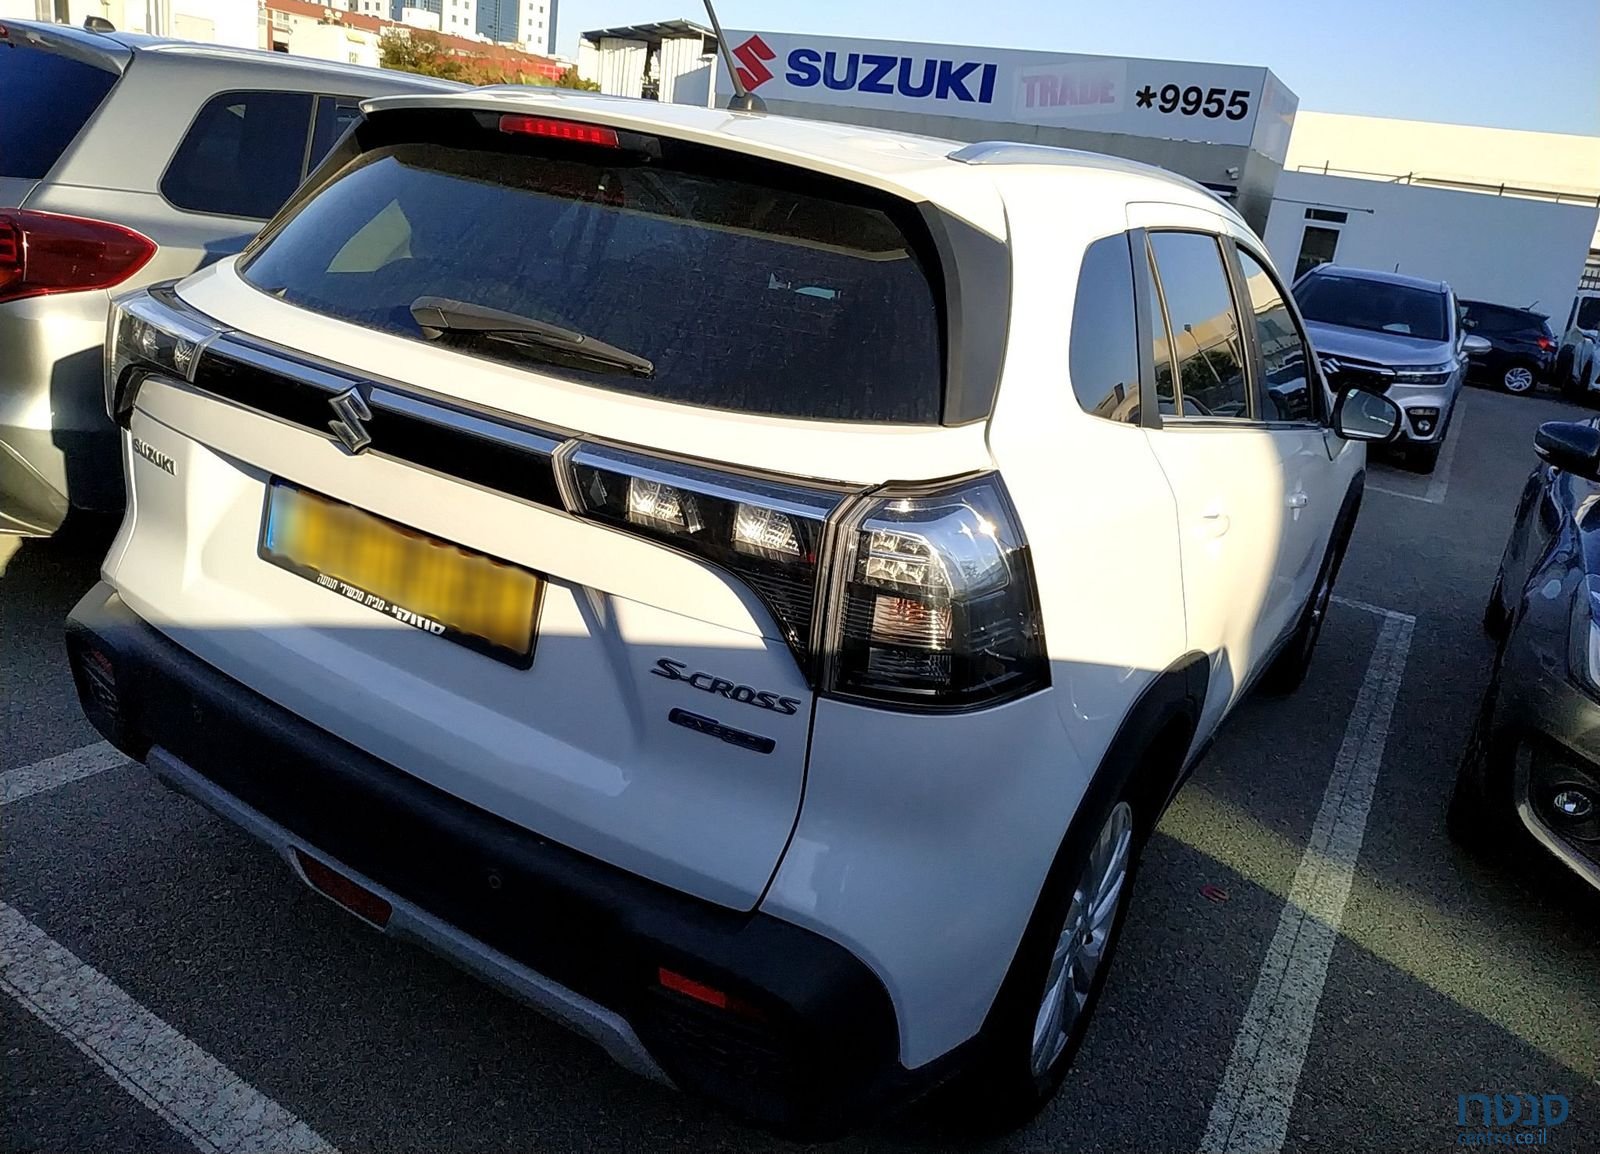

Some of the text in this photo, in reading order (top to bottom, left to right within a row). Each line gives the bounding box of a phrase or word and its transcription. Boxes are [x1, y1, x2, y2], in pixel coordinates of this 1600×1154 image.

[785, 48, 997, 104] SUZUKI
[133, 438, 176, 476] SUZUKI
[391, 605, 446, 635] סוזוקי
